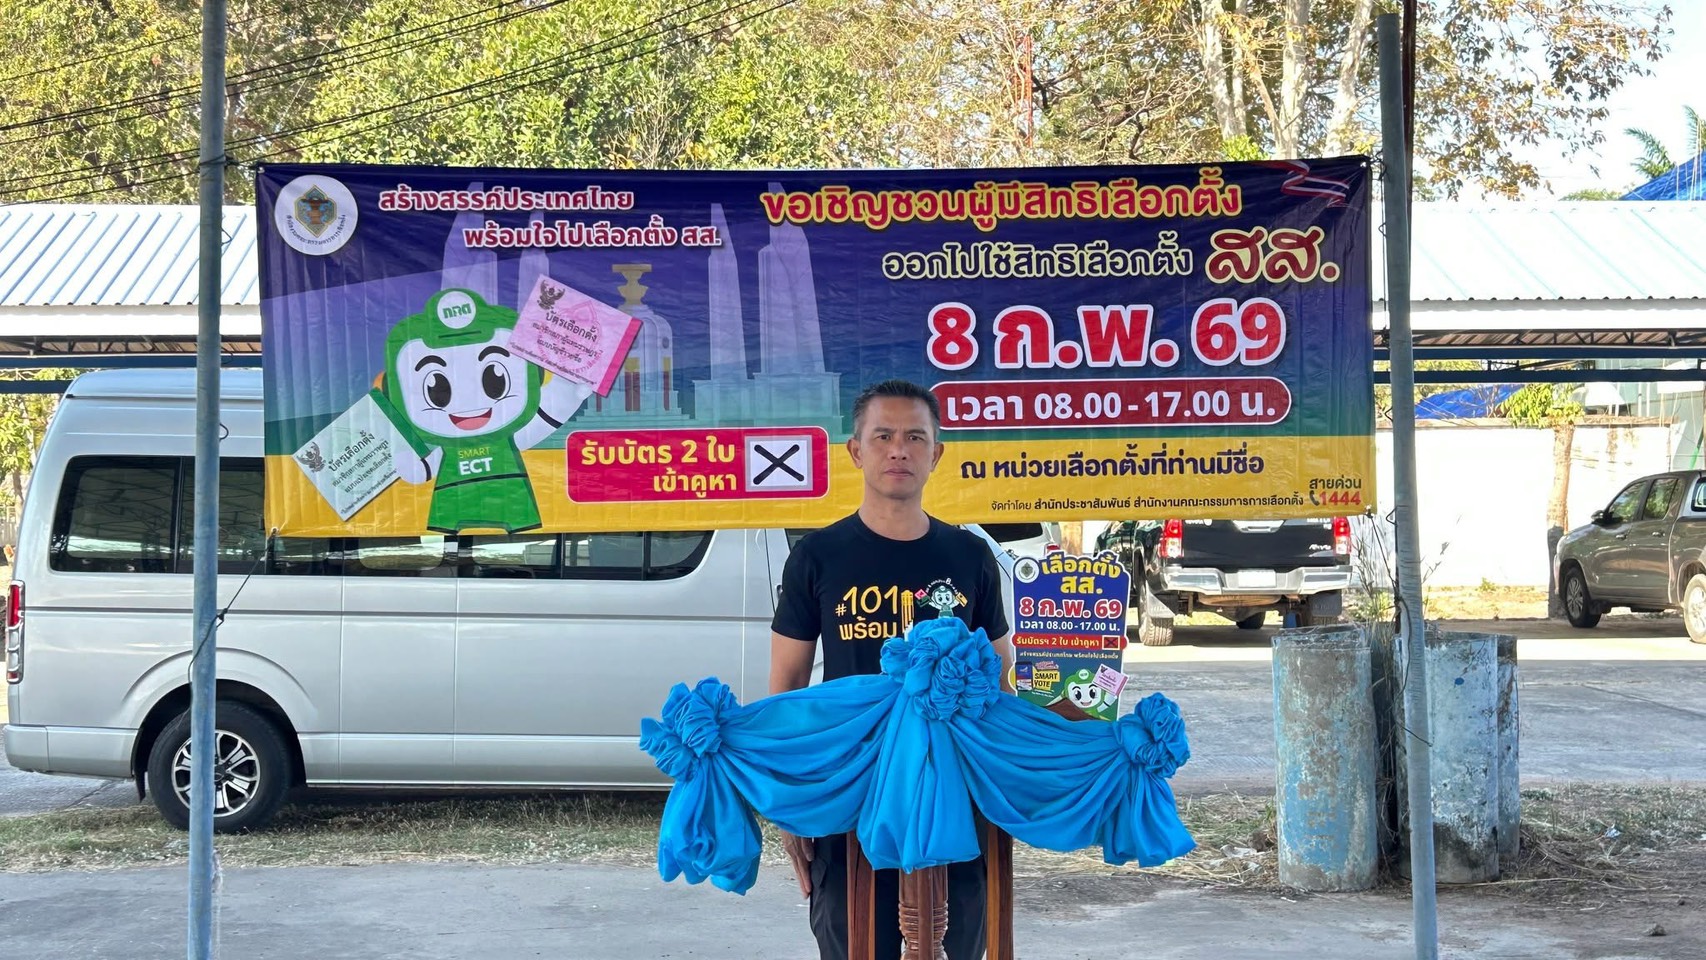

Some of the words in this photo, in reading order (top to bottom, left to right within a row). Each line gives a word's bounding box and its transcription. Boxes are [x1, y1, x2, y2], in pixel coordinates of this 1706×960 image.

[379, 184, 634, 210] สร้างสรรค์ประเทศไทย
[760, 167, 1242, 230] ขอเชิญชวนผู้มีสิทธิเลือกตั้ง
[463, 214, 678, 247] พร้อมใจไปเลือกตั้ง
[681, 226, 722, 247] สส.
[882, 231, 1193, 280] ออกไปใช้สิทธิเลือกตั้ง
[1206, 226, 1340, 284] สส.
[545, 309, 598, 342] บัตรเลือกตั้ง
[926, 302, 979, 370] 8
[993, 304, 1180, 369] ก.พ.
[1191, 297, 1286, 367] 69
[947, 395, 1024, 421] เวลา
[1034, 392, 1122, 420] 08.00
[1144, 391, 1230, 418] 17.00
[1241, 391, 1276, 417] น.
[328, 430, 375, 472] บัตรเลือกตั้ง
[458, 447, 491, 458] SMART
[581, 439, 673, 465] รับบัตร
[681, 440, 698, 463] 2
[706, 436, 735, 463] ใบ
[961, 460, 985, 479] ณ
[994, 442, 1265, 478] หน่วยเลือกตั้งที่ท่านมีชื่อ
[459, 457, 493, 475] ECT
[653, 467, 737, 498] เข้าคูหา
[1309, 475, 1362, 490] สายด่วน
[991, 500, 1032, 511] จัดทำโดย
[1034, 496, 1131, 510] สำนักประชาสัมพันธ์
[1134, 491, 1304, 509] สำนักงานคณะกรรมการการเลือกตั้ง
[1319, 491, 1361, 505] 1444
[1041, 554, 1121, 578] เลือกตั้ง
[1060, 576, 1103, 594] สส.
[835, 585, 898, 616] #101
[1019, 597, 1034, 616] 8
[1038, 598, 1091, 618] ก.พ.
[1094, 599, 1122, 619] 69
[839, 616, 897, 640] พร้อม
[1020, 620, 1044, 629] เวลา
[1046, 621, 1073, 630] 08.00
[1080, 621, 1106, 631] 17.00
[1109, 623, 1120, 631] น.
[1051, 637, 1057, 645] 2
[1059, 637, 1068, 645] ใบ
[1071, 638, 1099, 648] เข้าคูหา
[1034, 672, 1058, 680] SMART
[1034, 680, 1051, 688] VOTE
